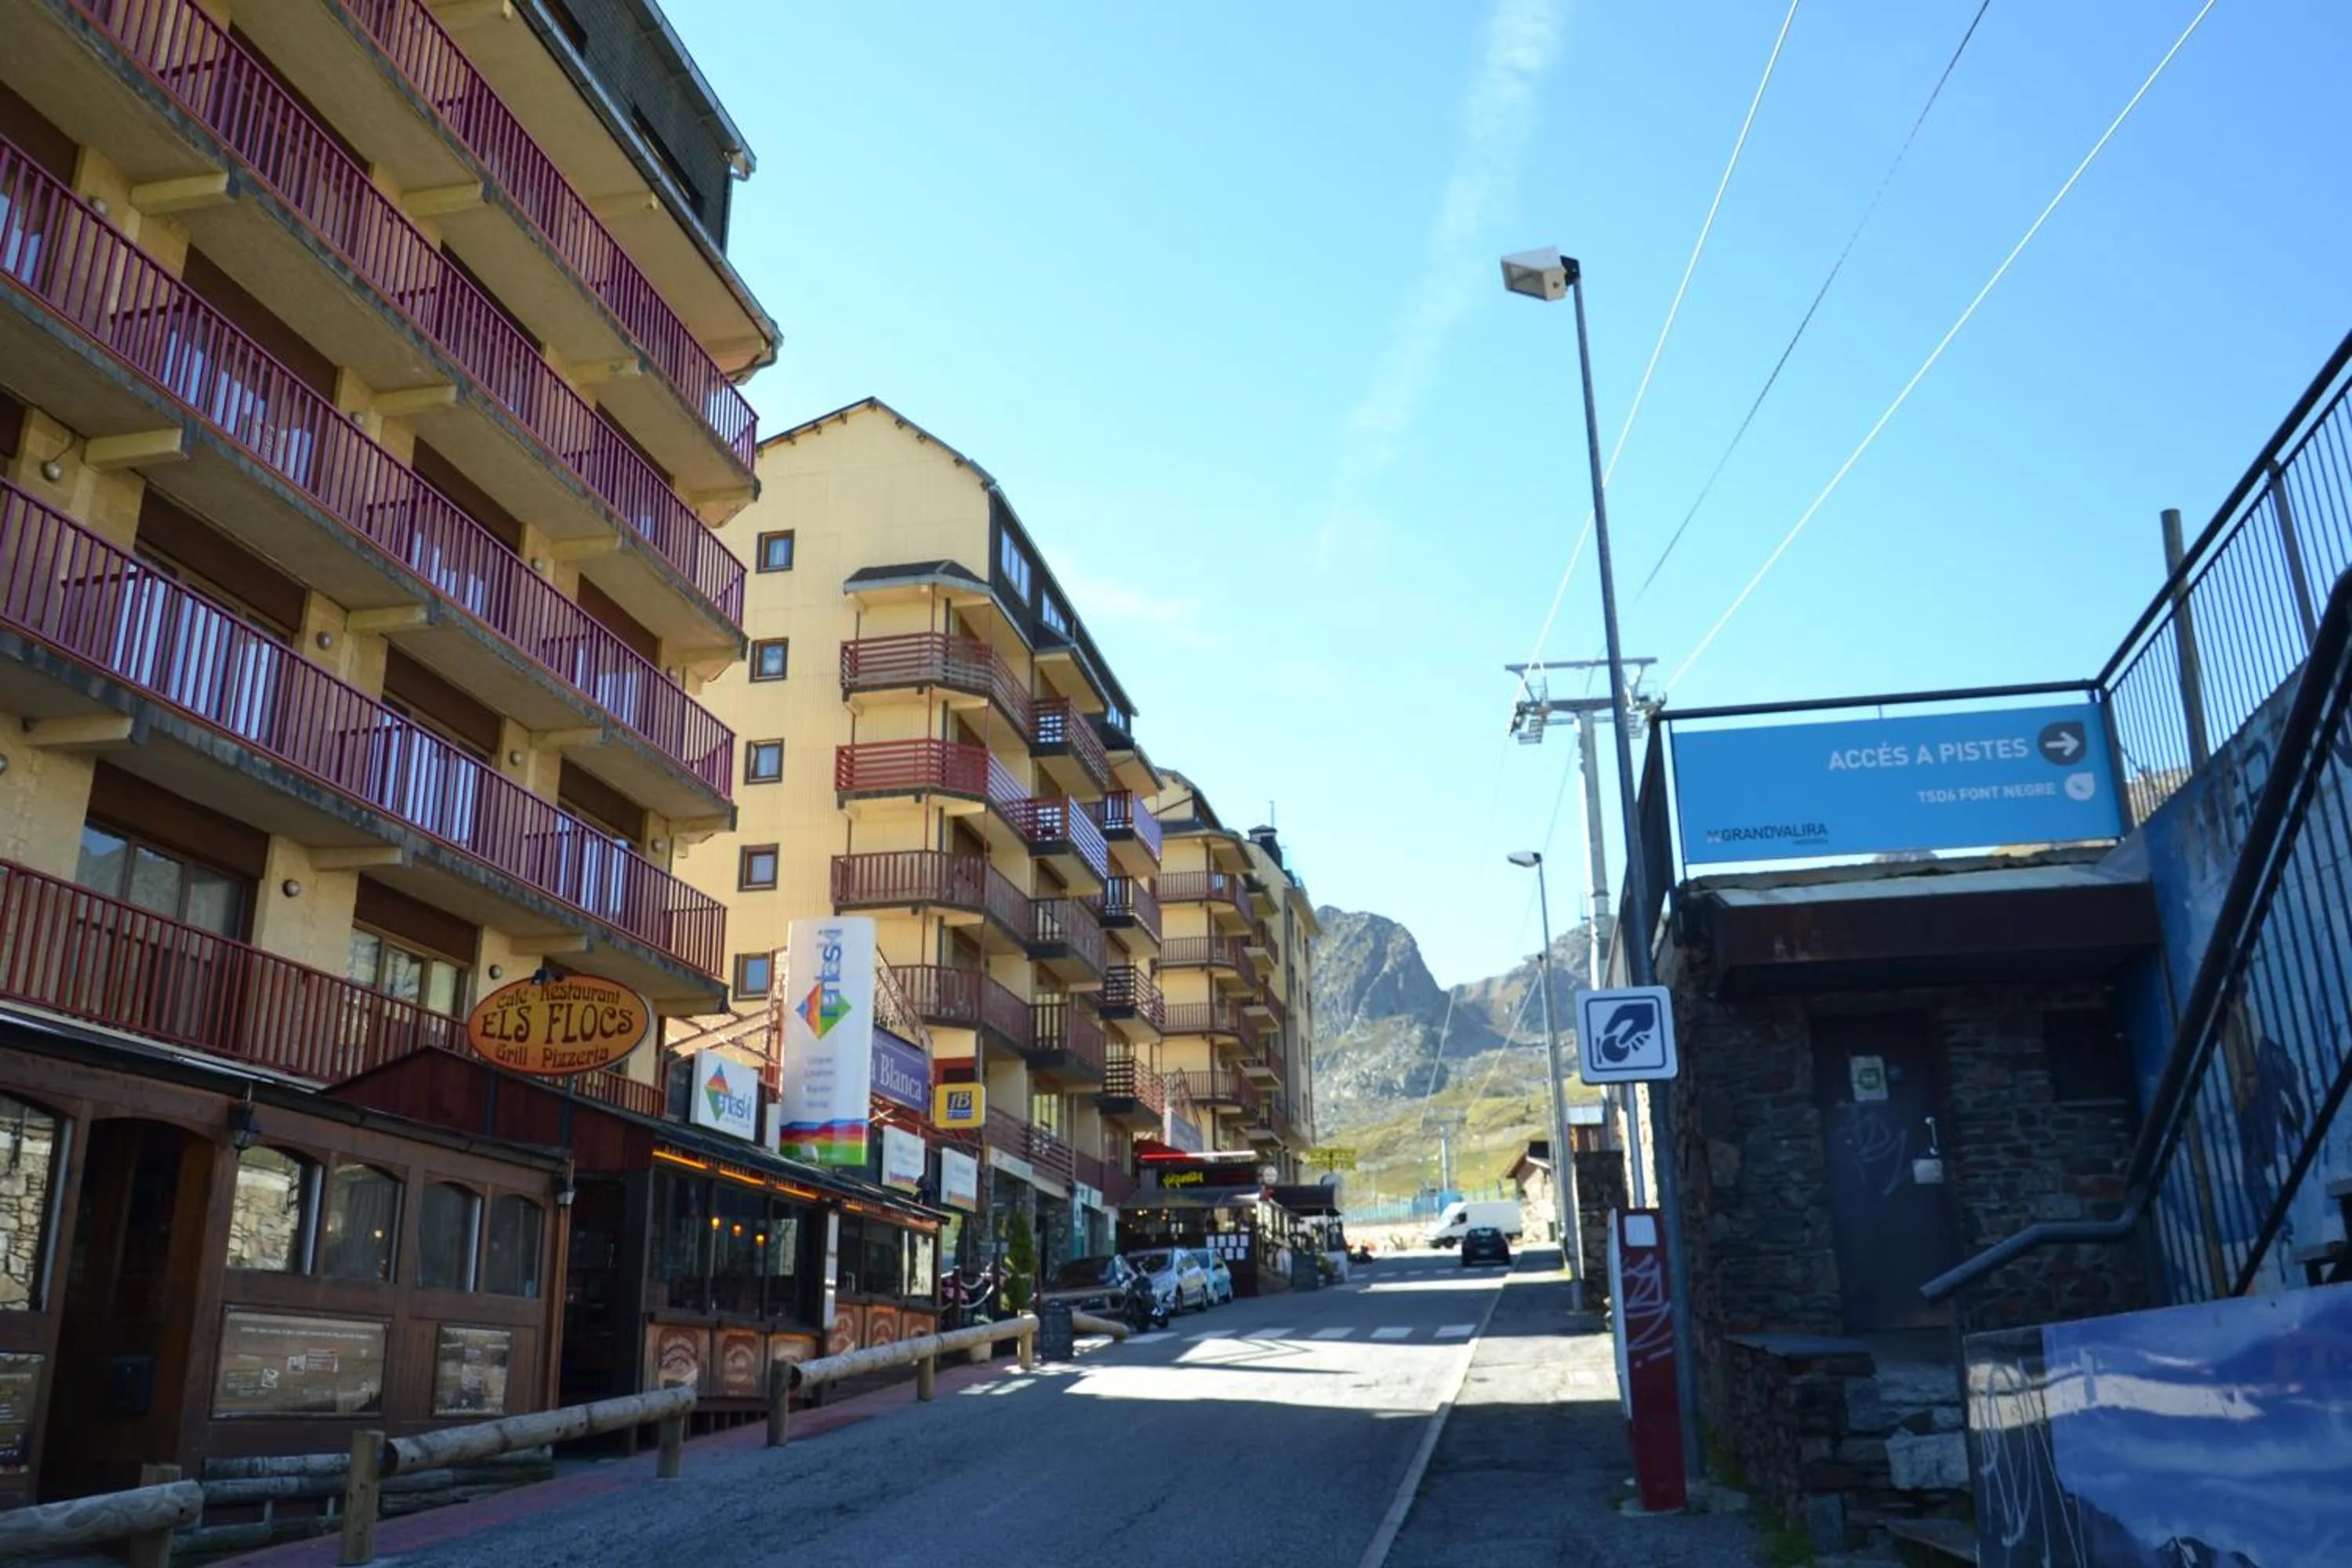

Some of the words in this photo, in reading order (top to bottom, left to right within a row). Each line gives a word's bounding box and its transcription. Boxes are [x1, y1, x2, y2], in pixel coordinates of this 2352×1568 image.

[1829, 741, 1909, 771] ACCÉS
[1916, 746, 1934, 765] A
[1940, 738, 2029, 764] PISTES
[1960, 786, 1999, 800] FONT
[2004, 782, 2056, 798] NEGRE
[1721, 822, 1828, 842] GRANDVALIRA
[540, 982, 621, 1004] Restaurant
[481, 1006, 532, 1044] ELS
[544, 1003, 633, 1045] FLOCS
[495, 1047, 528, 1066] Grill
[542, 1046, 610, 1068] Pizzeria
[880, 1053, 922, 1101] Blanca
